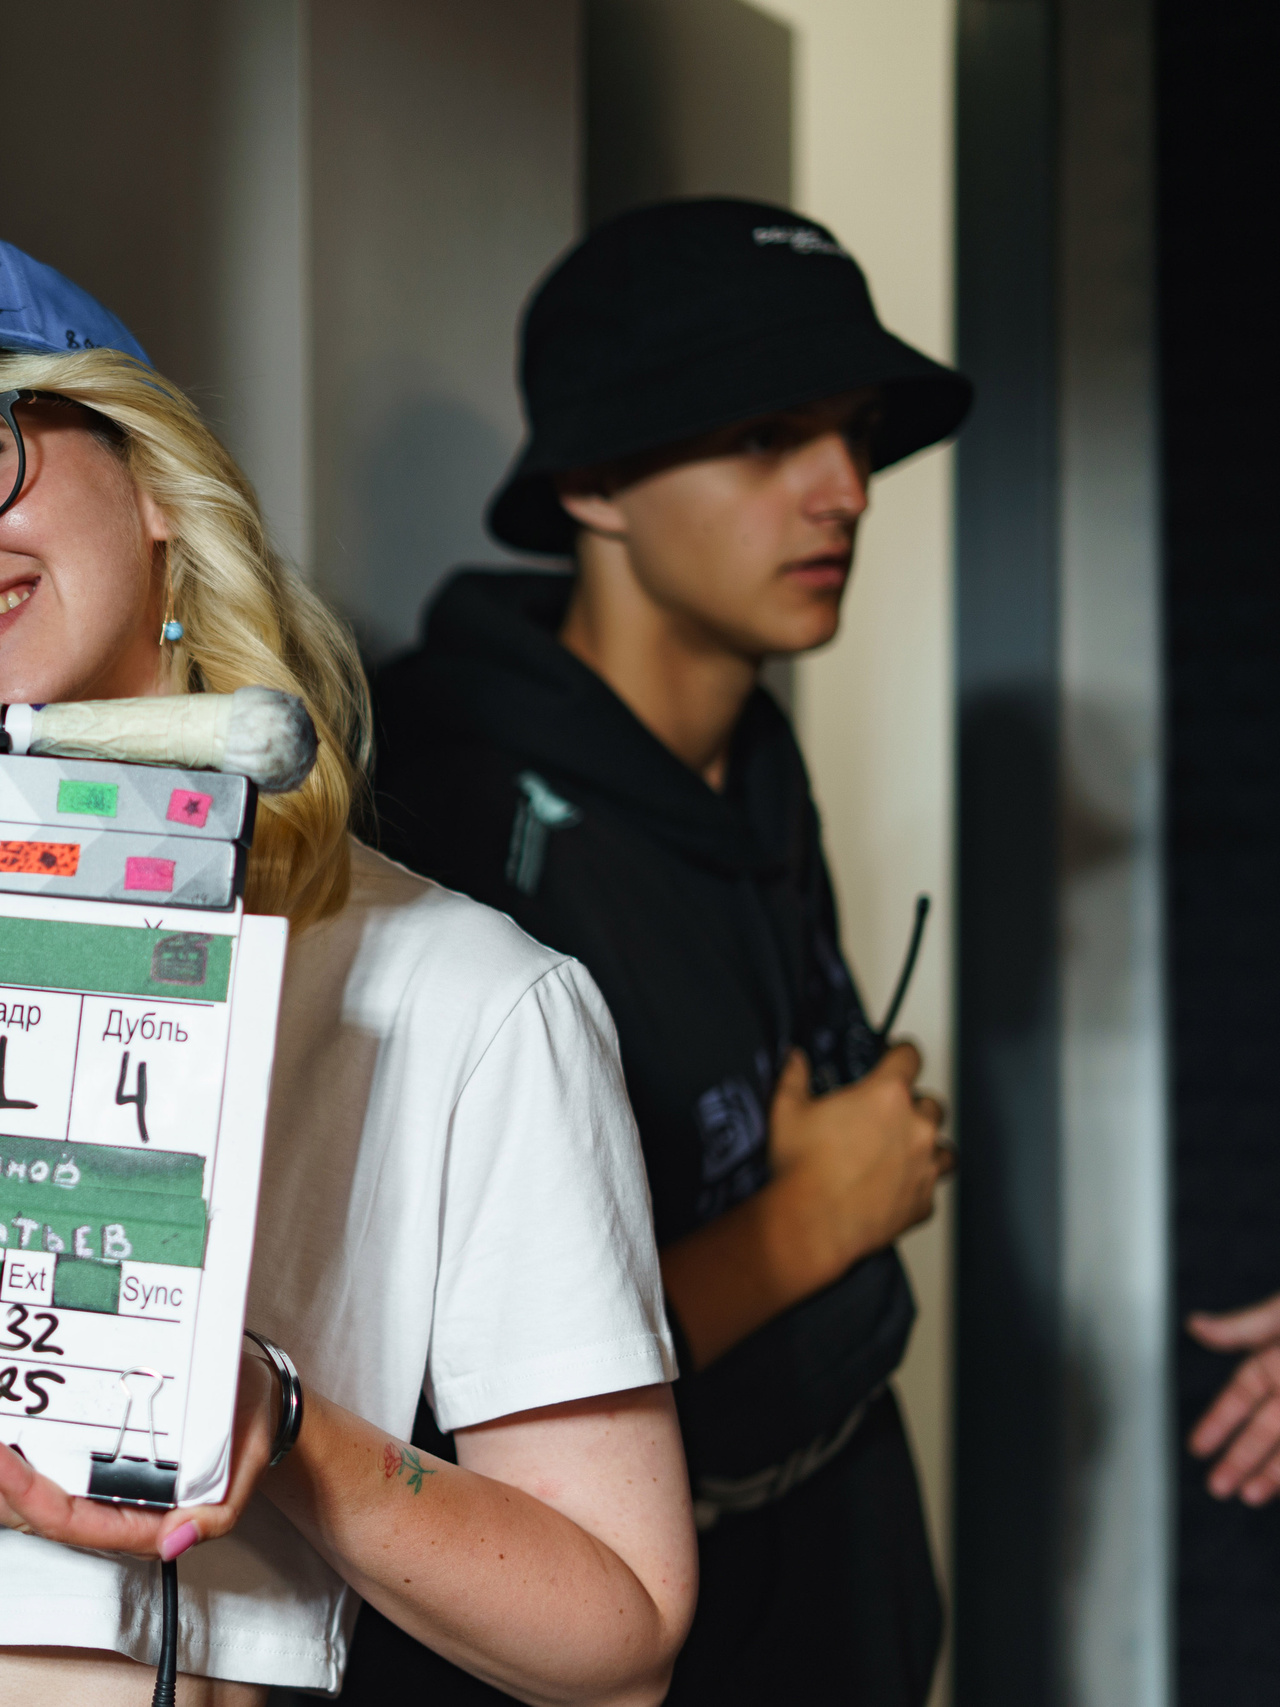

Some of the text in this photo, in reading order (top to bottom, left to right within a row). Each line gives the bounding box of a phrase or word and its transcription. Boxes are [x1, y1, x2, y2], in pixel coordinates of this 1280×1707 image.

[102, 1009, 189, 1044] Дубль
[115, 1050, 150, 1143] 4
[9, 1264, 46, 1291] Ext
[123, 1276, 183, 1310] Sync
